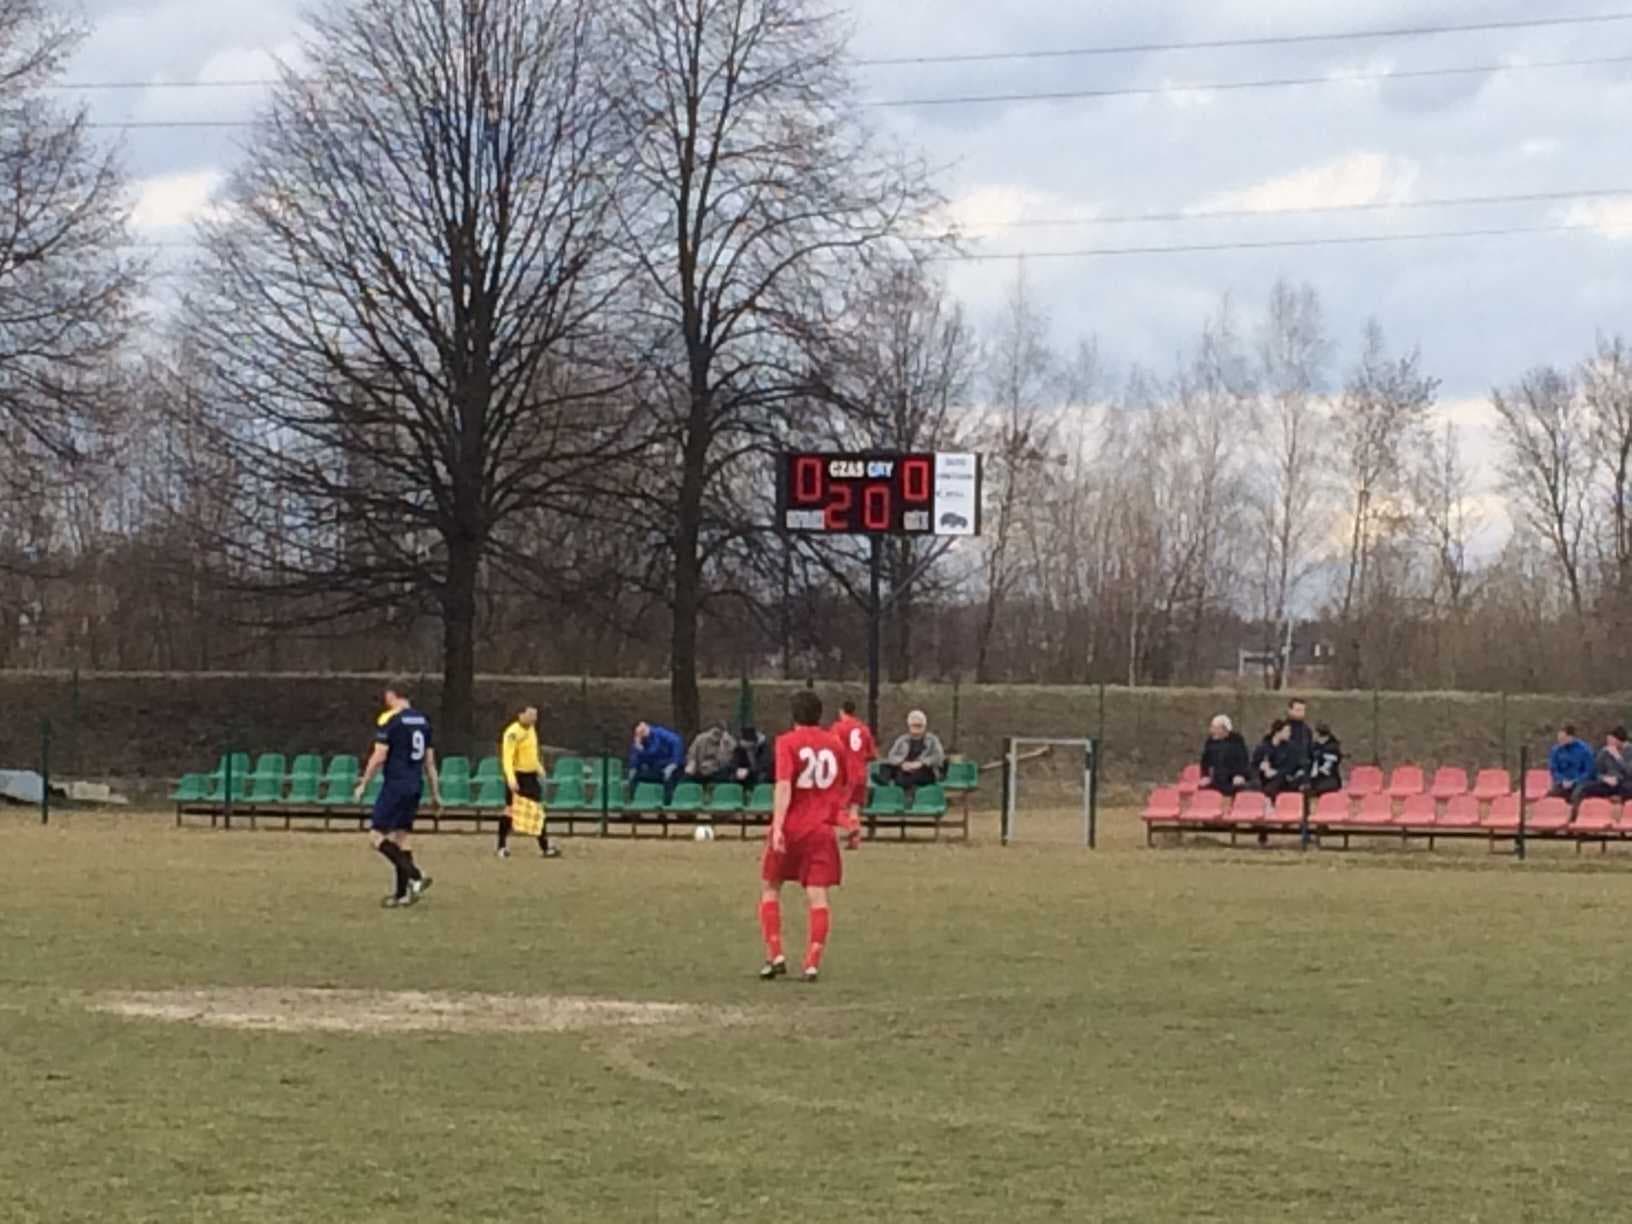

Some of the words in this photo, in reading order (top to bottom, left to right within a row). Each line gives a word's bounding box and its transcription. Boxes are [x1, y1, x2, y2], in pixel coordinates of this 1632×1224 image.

[797, 457, 822, 501] 0
[828, 460, 865, 478] CZAS
[903, 460, 929, 501] 0
[410, 730, 425, 760] 9
[849, 727, 862, 752] 6
[796, 746, 838, 789] 20
